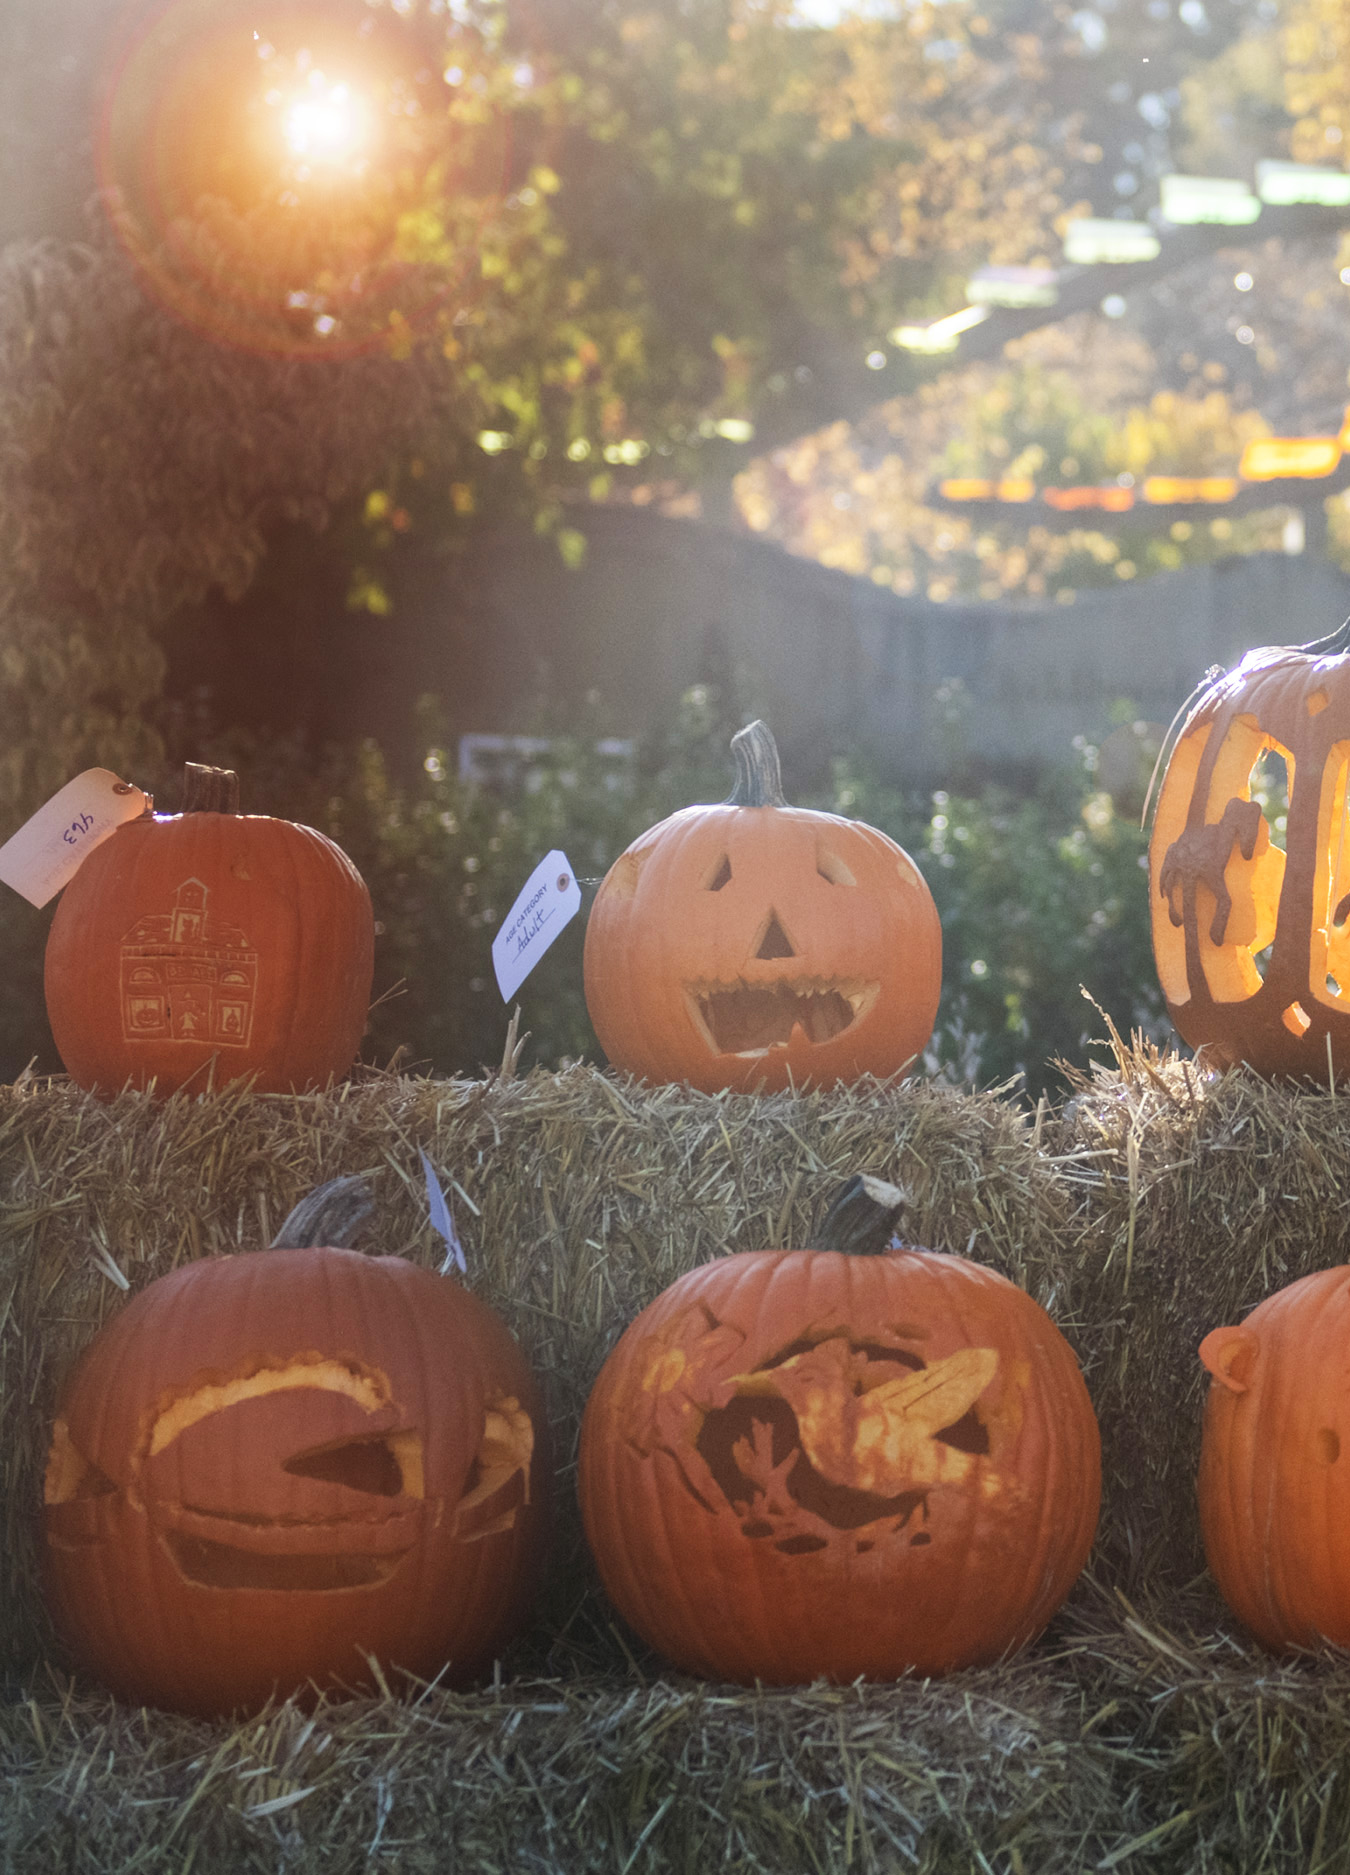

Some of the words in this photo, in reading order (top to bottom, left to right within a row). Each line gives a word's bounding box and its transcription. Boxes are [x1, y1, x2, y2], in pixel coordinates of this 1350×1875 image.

[63, 813, 94, 844] 463
[505, 925, 517, 944] AGE
[516, 883, 548, 928] CATEGORY
[517, 909, 544, 951] Adult
